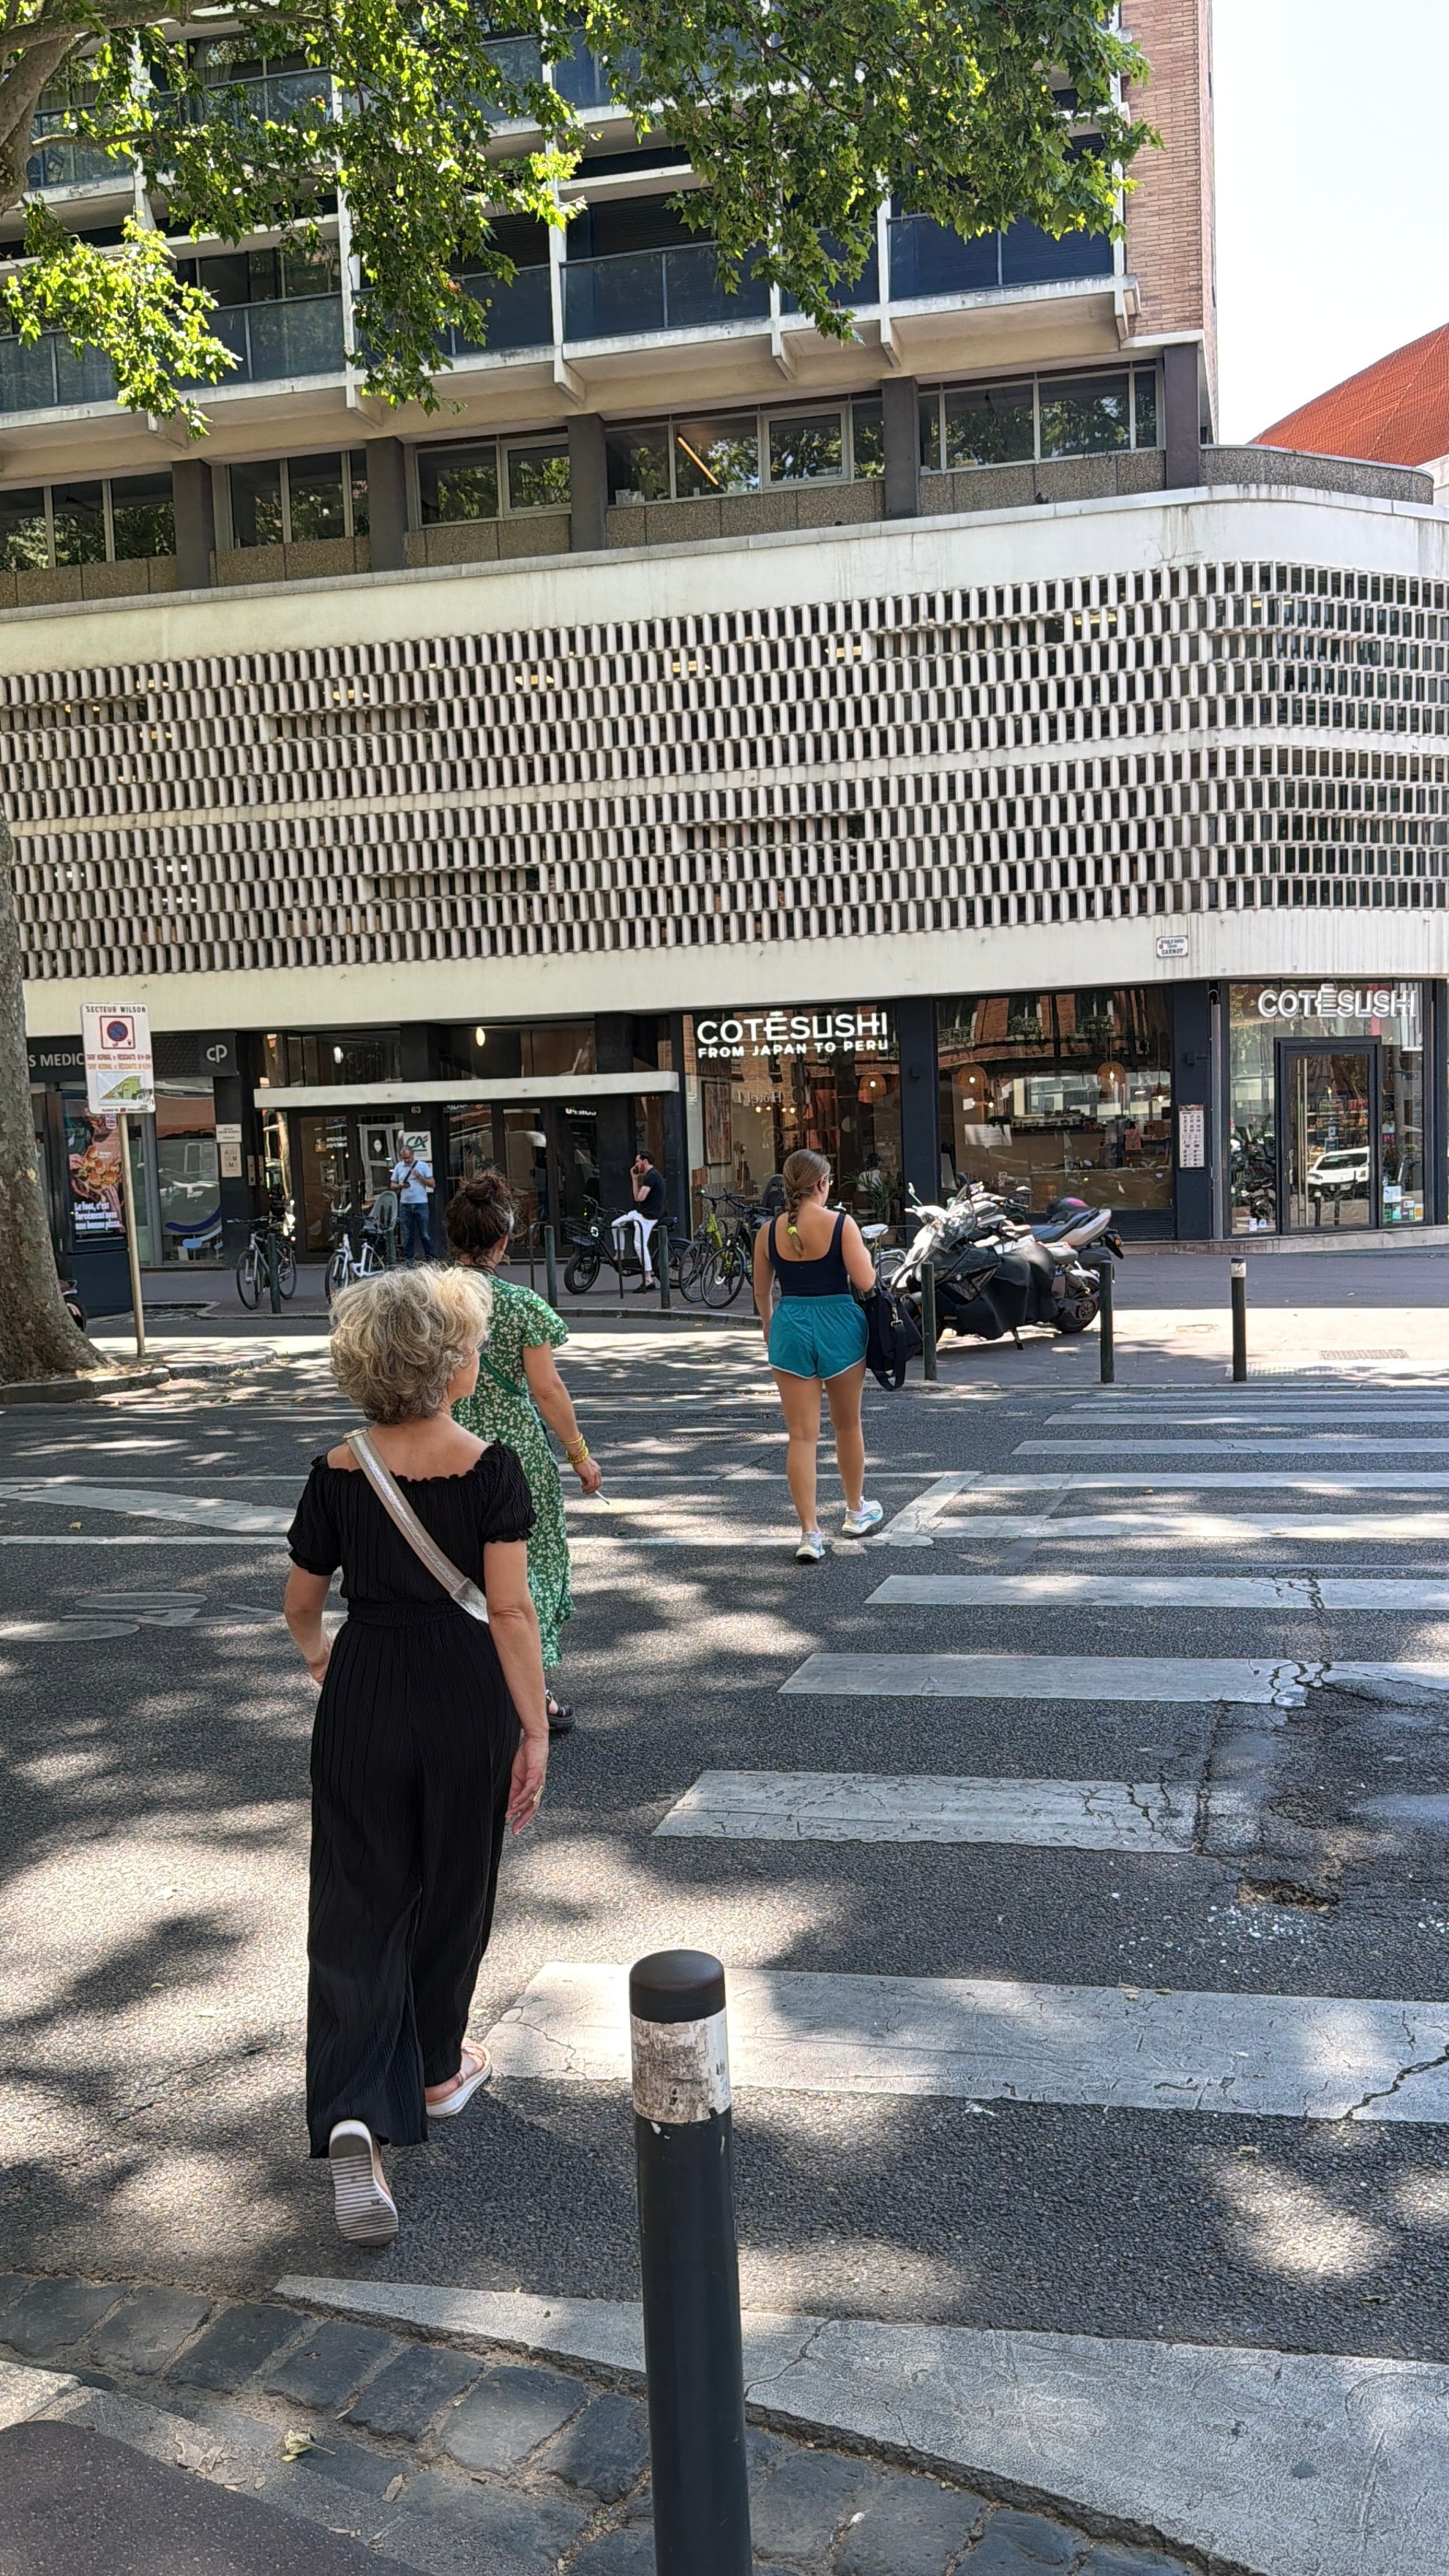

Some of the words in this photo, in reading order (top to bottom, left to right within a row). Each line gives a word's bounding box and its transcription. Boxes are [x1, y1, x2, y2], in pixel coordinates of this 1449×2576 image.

[86, 1006, 116, 1014] SECTEUR
[698, 1046, 744, 1058] FROM
[752, 1044, 806, 1056] JAPAN
[814, 1041, 836, 1052] TO
[843, 1039, 888, 1052] PERU
[411, 1106, 422, 1114] 63
